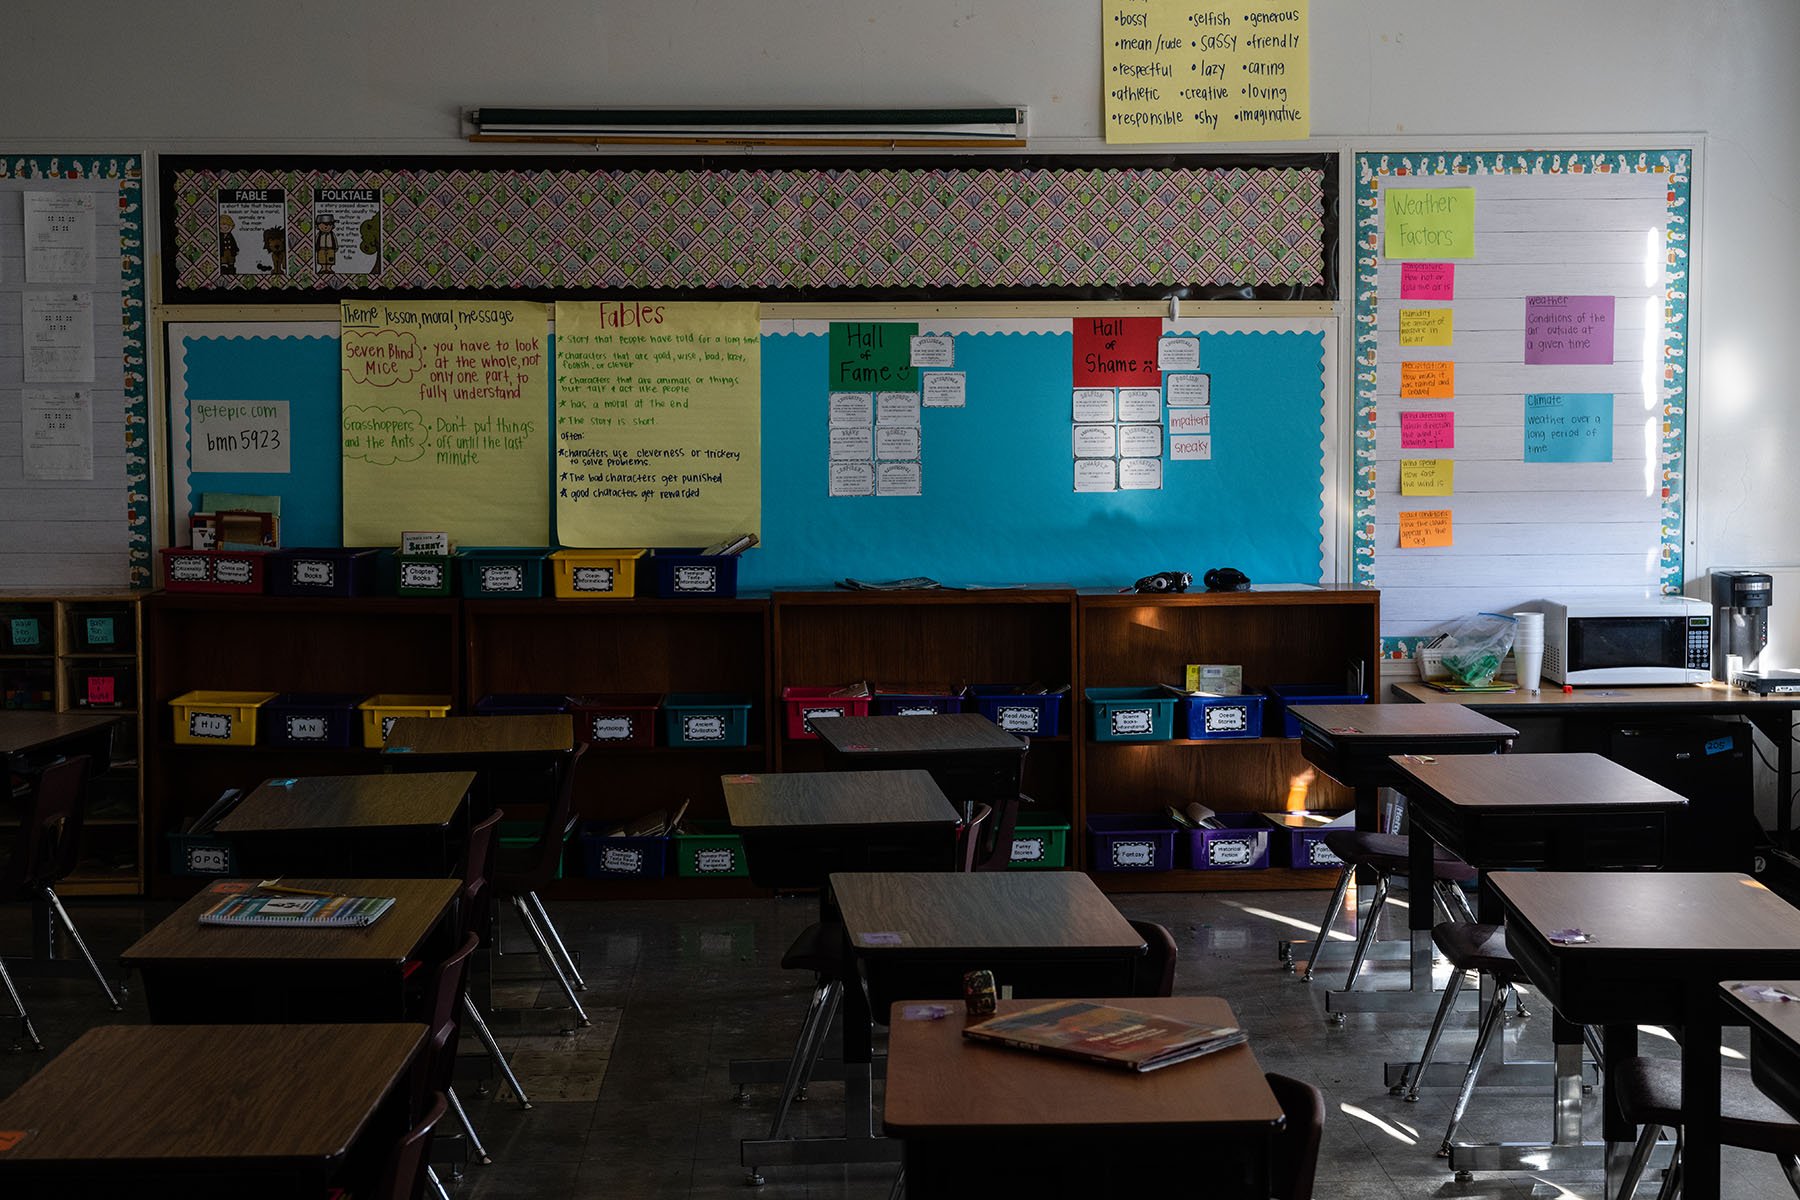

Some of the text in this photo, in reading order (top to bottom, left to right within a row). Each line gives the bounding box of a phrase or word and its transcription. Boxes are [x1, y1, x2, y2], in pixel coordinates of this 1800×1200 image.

[1120, 10, 1299, 28] bossy selfish generous
[1120, 38, 1152, 50] mean
[1201, 33, 1237, 51] sassy
[1252, 34, 1299, 49] friendly
[1119, 60, 1285, 80] respectful lazy caring
[1116, 84, 1286, 102] athletic creative loving
[1117, 105, 1301, 130] responsible shy imaginative
[235, 191, 267, 201] FABLE
[321, 190, 373, 201] FOLKTALE
[1393, 193, 1457, 215] Weather
[1400, 223, 1453, 247] Factors
[384, 307, 422, 329] lesson,
[422, 309, 458, 330] moral,
[459, 309, 514, 326] message
[600, 302, 665, 329] Fables
[1577, 312, 1586, 323] of
[1589, 313, 1605, 322] the
[1093, 319, 1122, 337] Hall
[1527, 326, 1594, 335] air outside at
[595, 335, 612, 343] that
[650, 335, 672, 343] have
[676, 333, 694, 343] told
[698, 335, 711, 343] for
[724, 335, 740, 346] long
[847, 323, 883, 349] Hall
[346, 343, 413, 359] Seven Blind
[433, 337, 539, 356] you have to look
[1105, 340, 1116, 350] of
[1527, 339, 1590, 352] a given time
[435, 353, 541, 371] at the whole, not
[613, 352, 630, 360] that
[860, 350, 871, 360] of
[366, 361, 398, 375] Mice
[1086, 353, 1136, 373] Shame
[430, 370, 453, 386] only
[457, 372, 477, 383] one
[518, 372, 529, 385] to
[841, 361, 891, 384] Fame
[419, 385, 521, 402] fully understand
[1527, 395, 1562, 406] Climate
[570, 400, 587, 409] has
[604, 400, 628, 408] moral
[634, 400, 643, 408] at
[670, 399, 689, 408] end
[344, 417, 414, 433] Grasshoppers
[436, 416, 534, 438] Don't put things
[568, 416, 584, 425] The
[617, 417, 626, 425] is
[1171, 413, 1210, 429] impatient
[1571, 416, 1590, 424] over
[1595, 416, 1601, 424] a
[207, 429, 280, 451] bmn 5923
[345, 434, 415, 448] and the Ants
[1551, 430, 1579, 440] period
[1586, 429, 1598, 437] of
[436, 435, 525, 449] off until the last
[1175, 440, 1208, 454] sneaky
[1528, 444, 1548, 453] time
[436, 452, 479, 465] minute
[564, 448, 740, 461] characters use cleverness or trickery
[582, 458, 603, 466] solve
[570, 472, 722, 487] The bad characters get punished
[571, 488, 700, 502] good characters get rewarded
